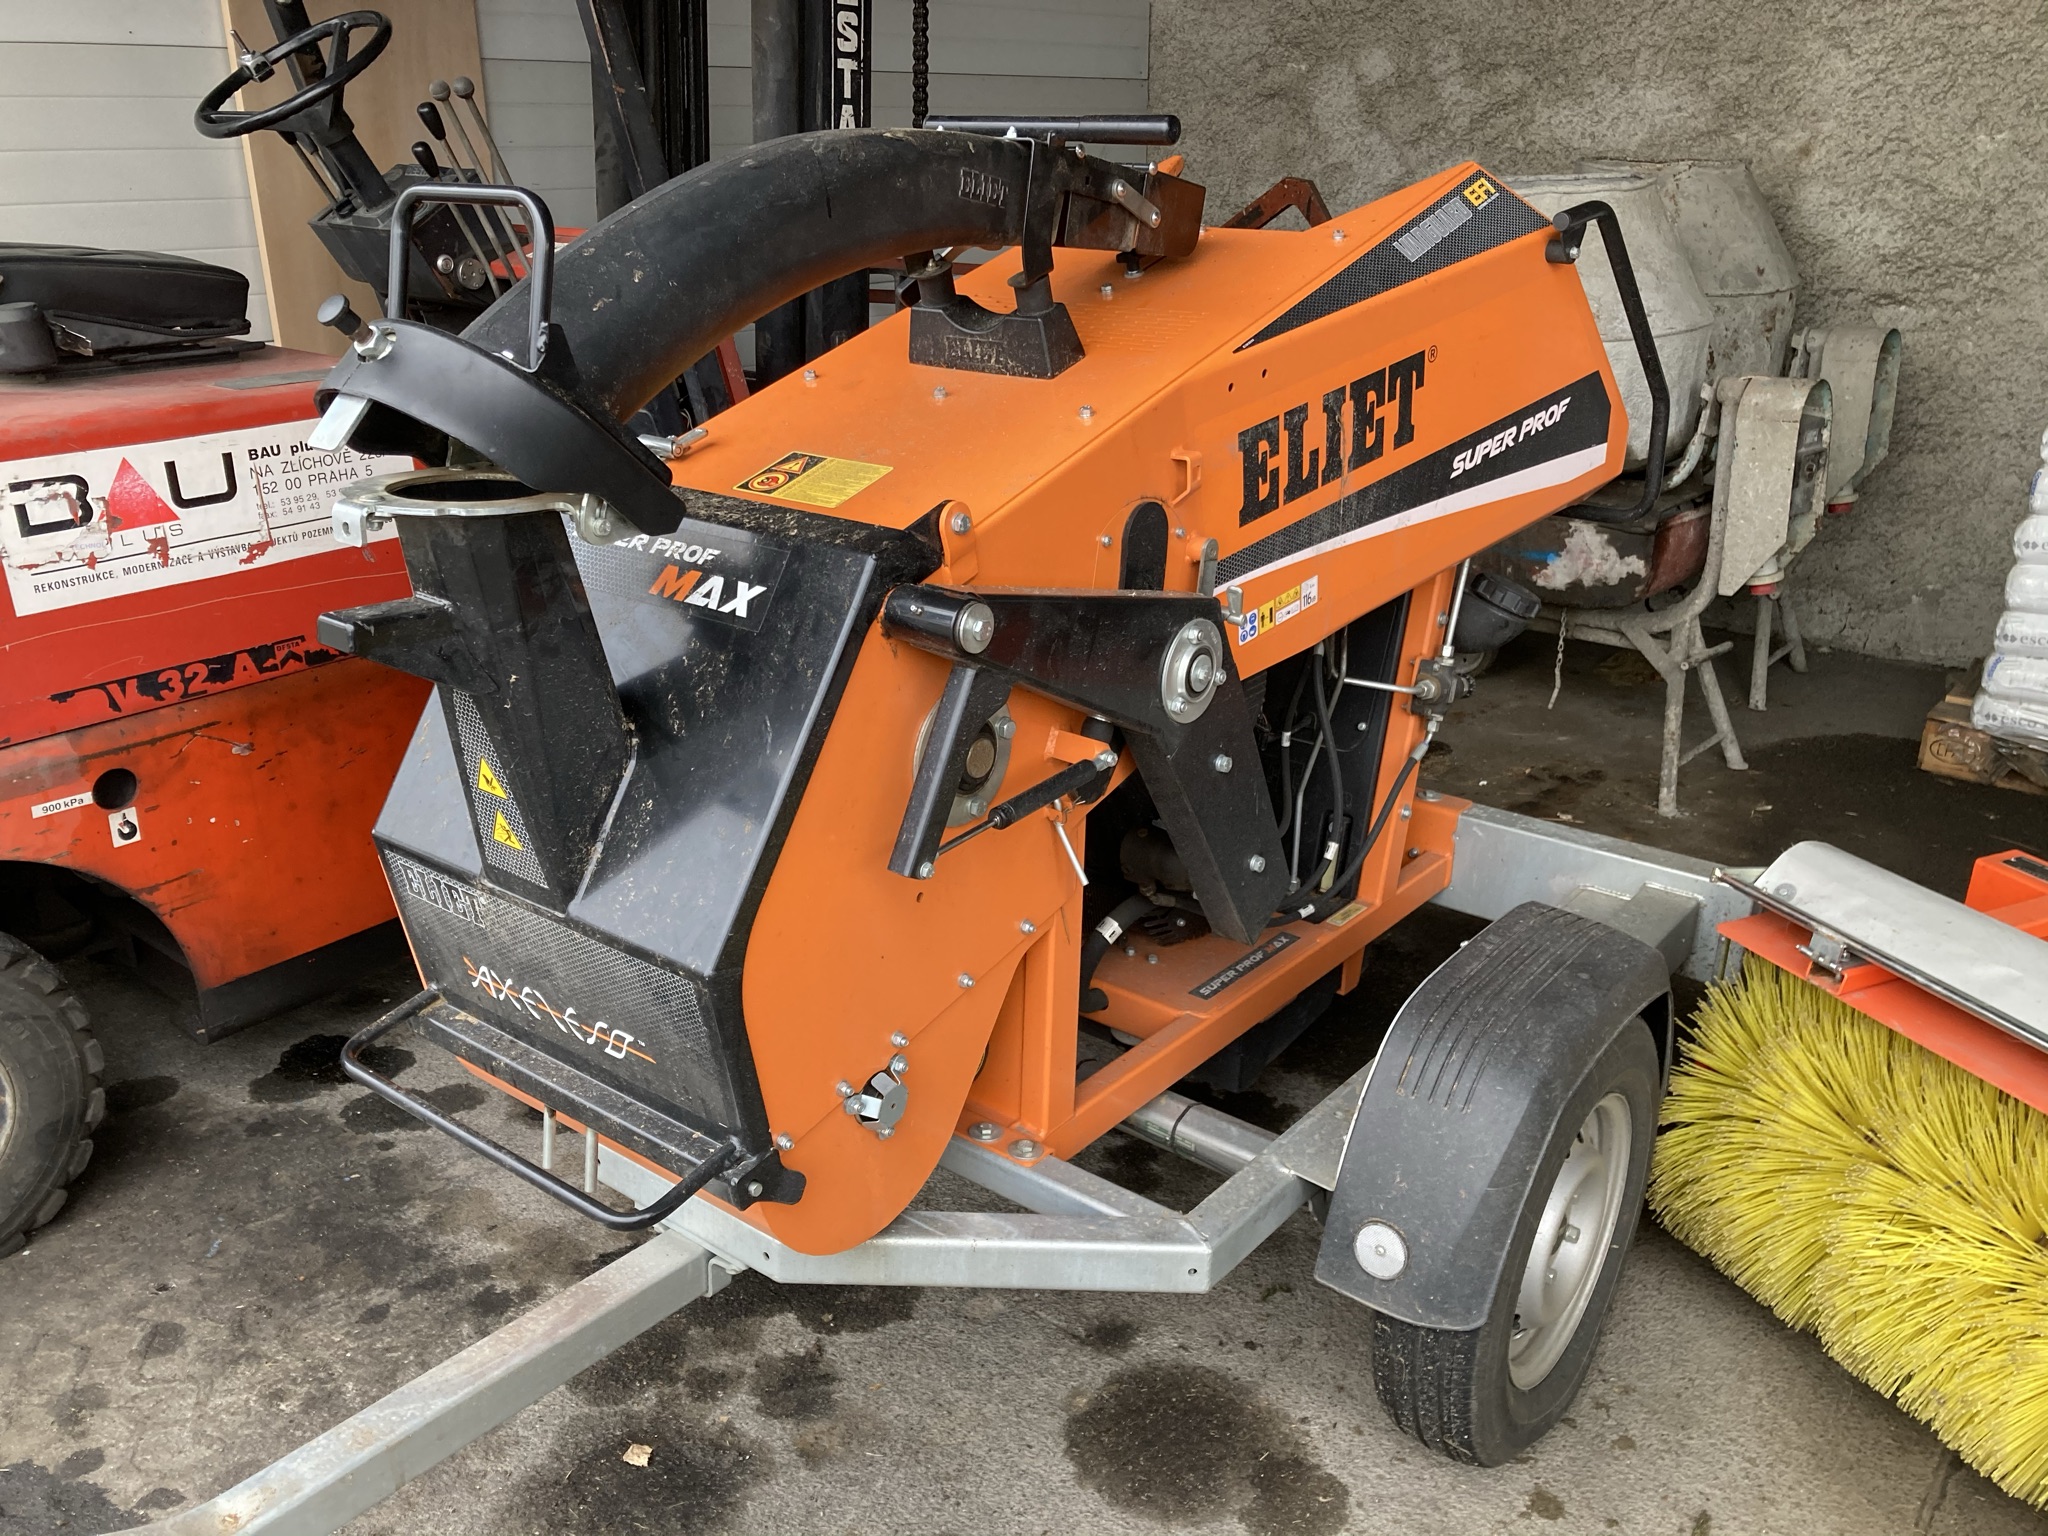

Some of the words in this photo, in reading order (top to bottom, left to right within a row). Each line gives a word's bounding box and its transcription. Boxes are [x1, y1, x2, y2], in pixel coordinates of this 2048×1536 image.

[957, 167, 1010, 208] ELIET
[1392, 196, 1473, 262] VANGUARD
[248, 444, 281, 461] BAU
[1238, 349, 1426, 528] ELIET
[1450, 424, 1518, 479] SUPER
[1517, 396, 1572, 443] PROF
[250, 464, 274, 480] NA
[281, 448, 352, 474] ZLÍCHOVĚ
[253, 481, 279, 496] 152
[285, 477, 302, 491] 00
[308, 467, 359, 487] PRAHA
[365, 464, 373, 477] 5
[280, 498, 291, 506] 53
[293, 496, 304, 505] 95
[282, 508, 294, 517] 54
[297, 505, 306, 513] 91
[310, 502, 320, 511] 43
[122, 554, 193, 577] MODERNZACE
[198, 553, 204, 562] A
[649, 537, 722, 566] PROF
[648, 564, 768, 618] MAX
[158, 663, 209, 701] 32
[42, 802, 61, 814] 900
[64, 798, 84, 809] kPa
[399, 861, 485, 928] ELIET
[1200, 969, 1238, 996] SUPER
[1236, 950, 1264, 972] PROF
[1264, 936, 1290, 954] MAX
